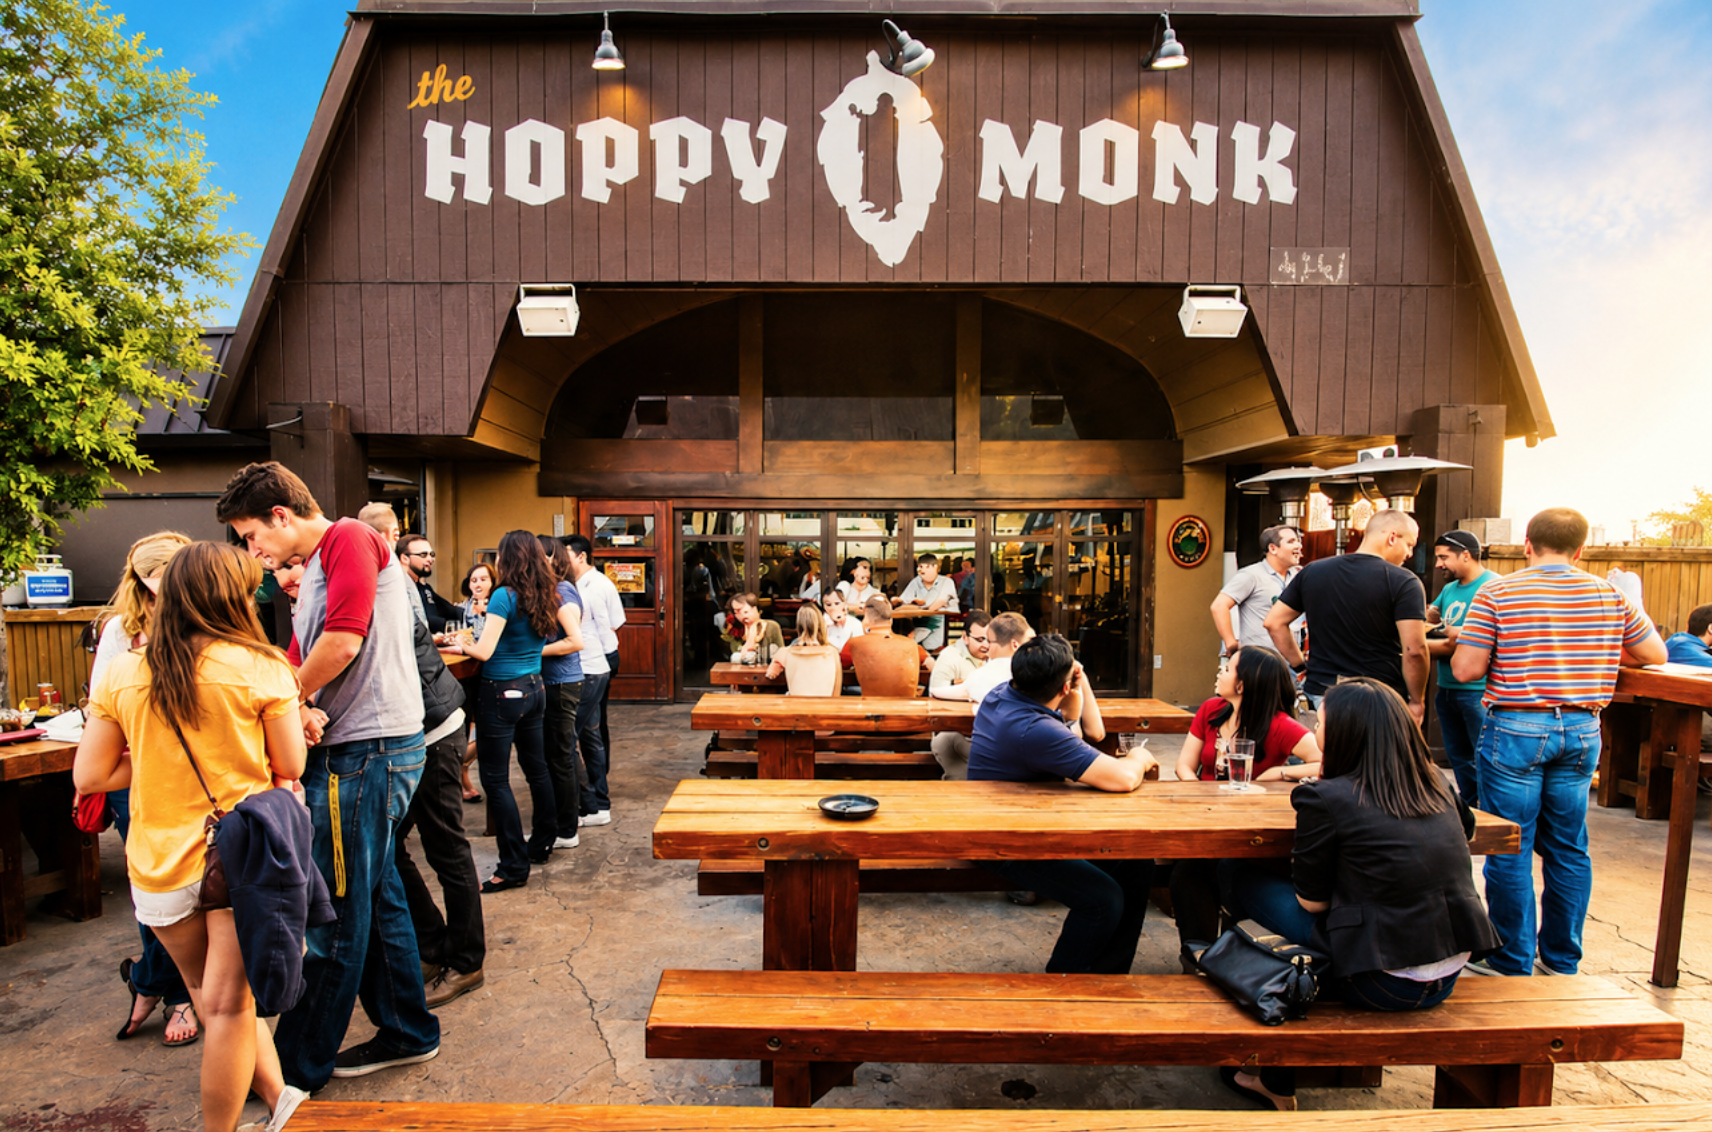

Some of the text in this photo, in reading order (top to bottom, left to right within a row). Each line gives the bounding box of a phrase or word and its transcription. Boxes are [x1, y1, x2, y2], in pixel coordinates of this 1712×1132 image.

[407, 64, 475, 109] the
[423, 116, 1298, 206] HOPPY MONK
